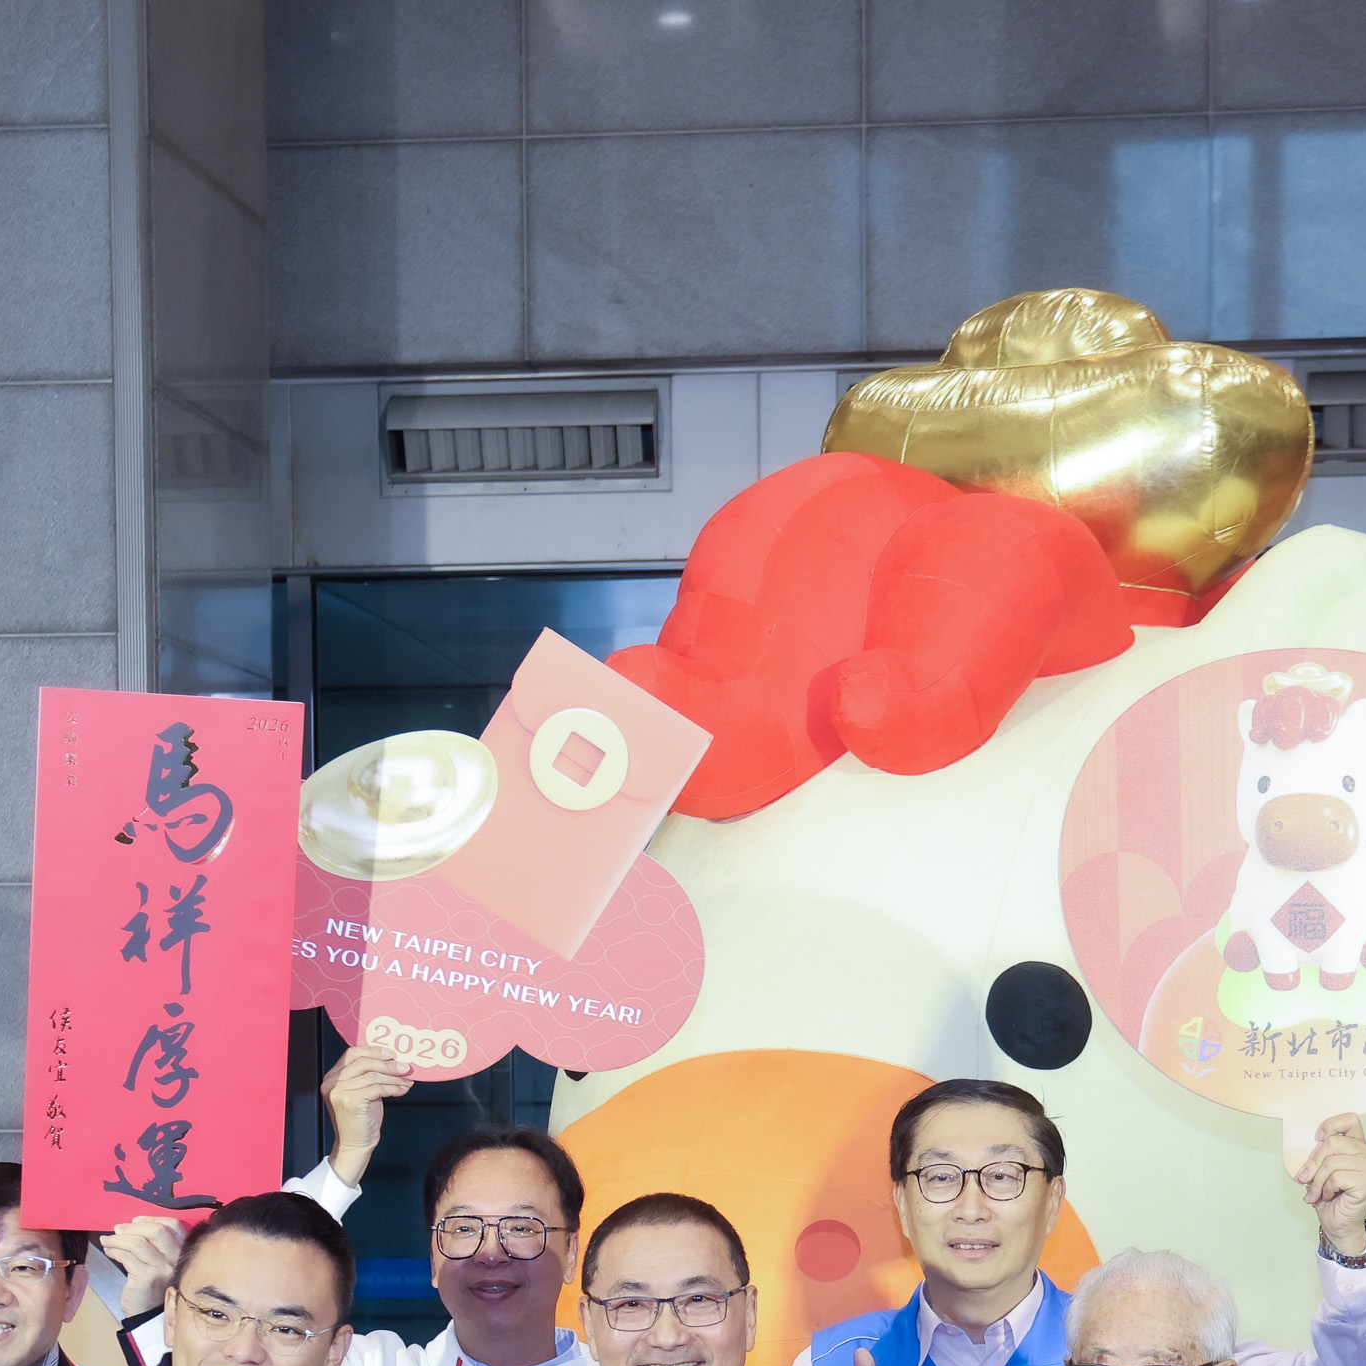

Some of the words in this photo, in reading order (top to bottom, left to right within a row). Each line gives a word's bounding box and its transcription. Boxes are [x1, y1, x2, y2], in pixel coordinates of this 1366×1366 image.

[246, 716, 289, 733] 2026
[1288, 902, 1327, 941] 福
[325, 917, 384, 944] NEW
[391, 930, 473, 963] TAIPEI
[480, 948, 543, 976] CITY
[326, 945, 379, 971] YOU
[385, 959, 404, 977] A
[411, 962, 497, 996] HAPPY
[502, 981, 561, 1008] NEW
[567, 994, 643, 1026] YEAR!
[371, 1023, 462, 1060] 2026
[1243, 1068, 1273, 1079] New
[1279, 1067, 1322, 1081] Taipei
[1328, 1067, 1357, 1081] City
